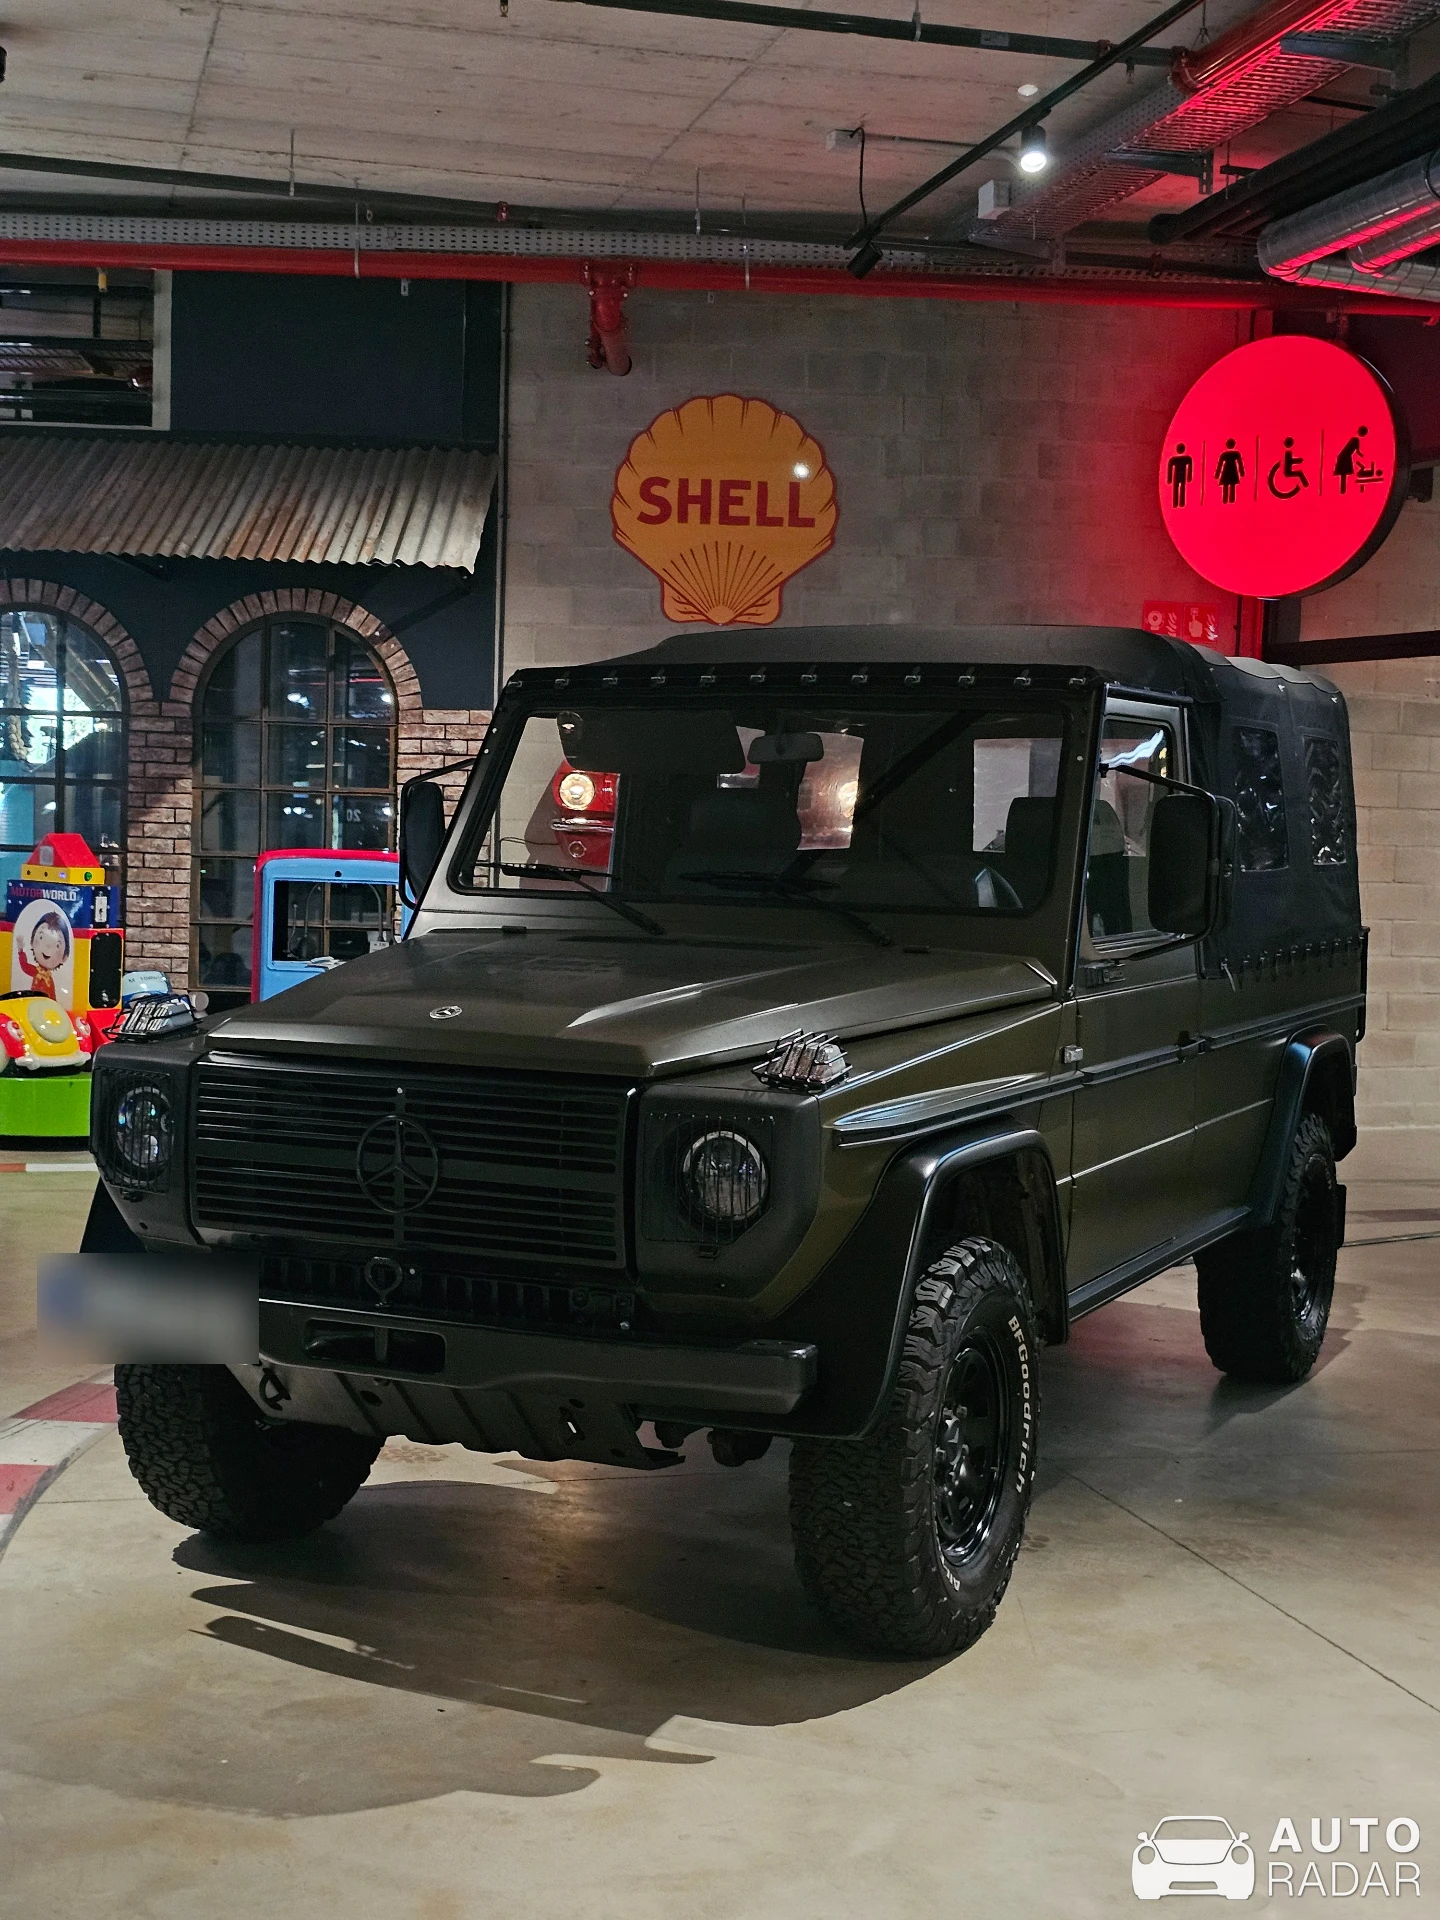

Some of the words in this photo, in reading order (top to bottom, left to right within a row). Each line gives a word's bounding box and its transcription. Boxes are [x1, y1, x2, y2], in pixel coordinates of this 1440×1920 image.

[637, 476, 816, 528] SHELL
[11, 886, 77, 902] MOTORWORLD
[1008, 1315, 1031, 1493] BFGoodrich
